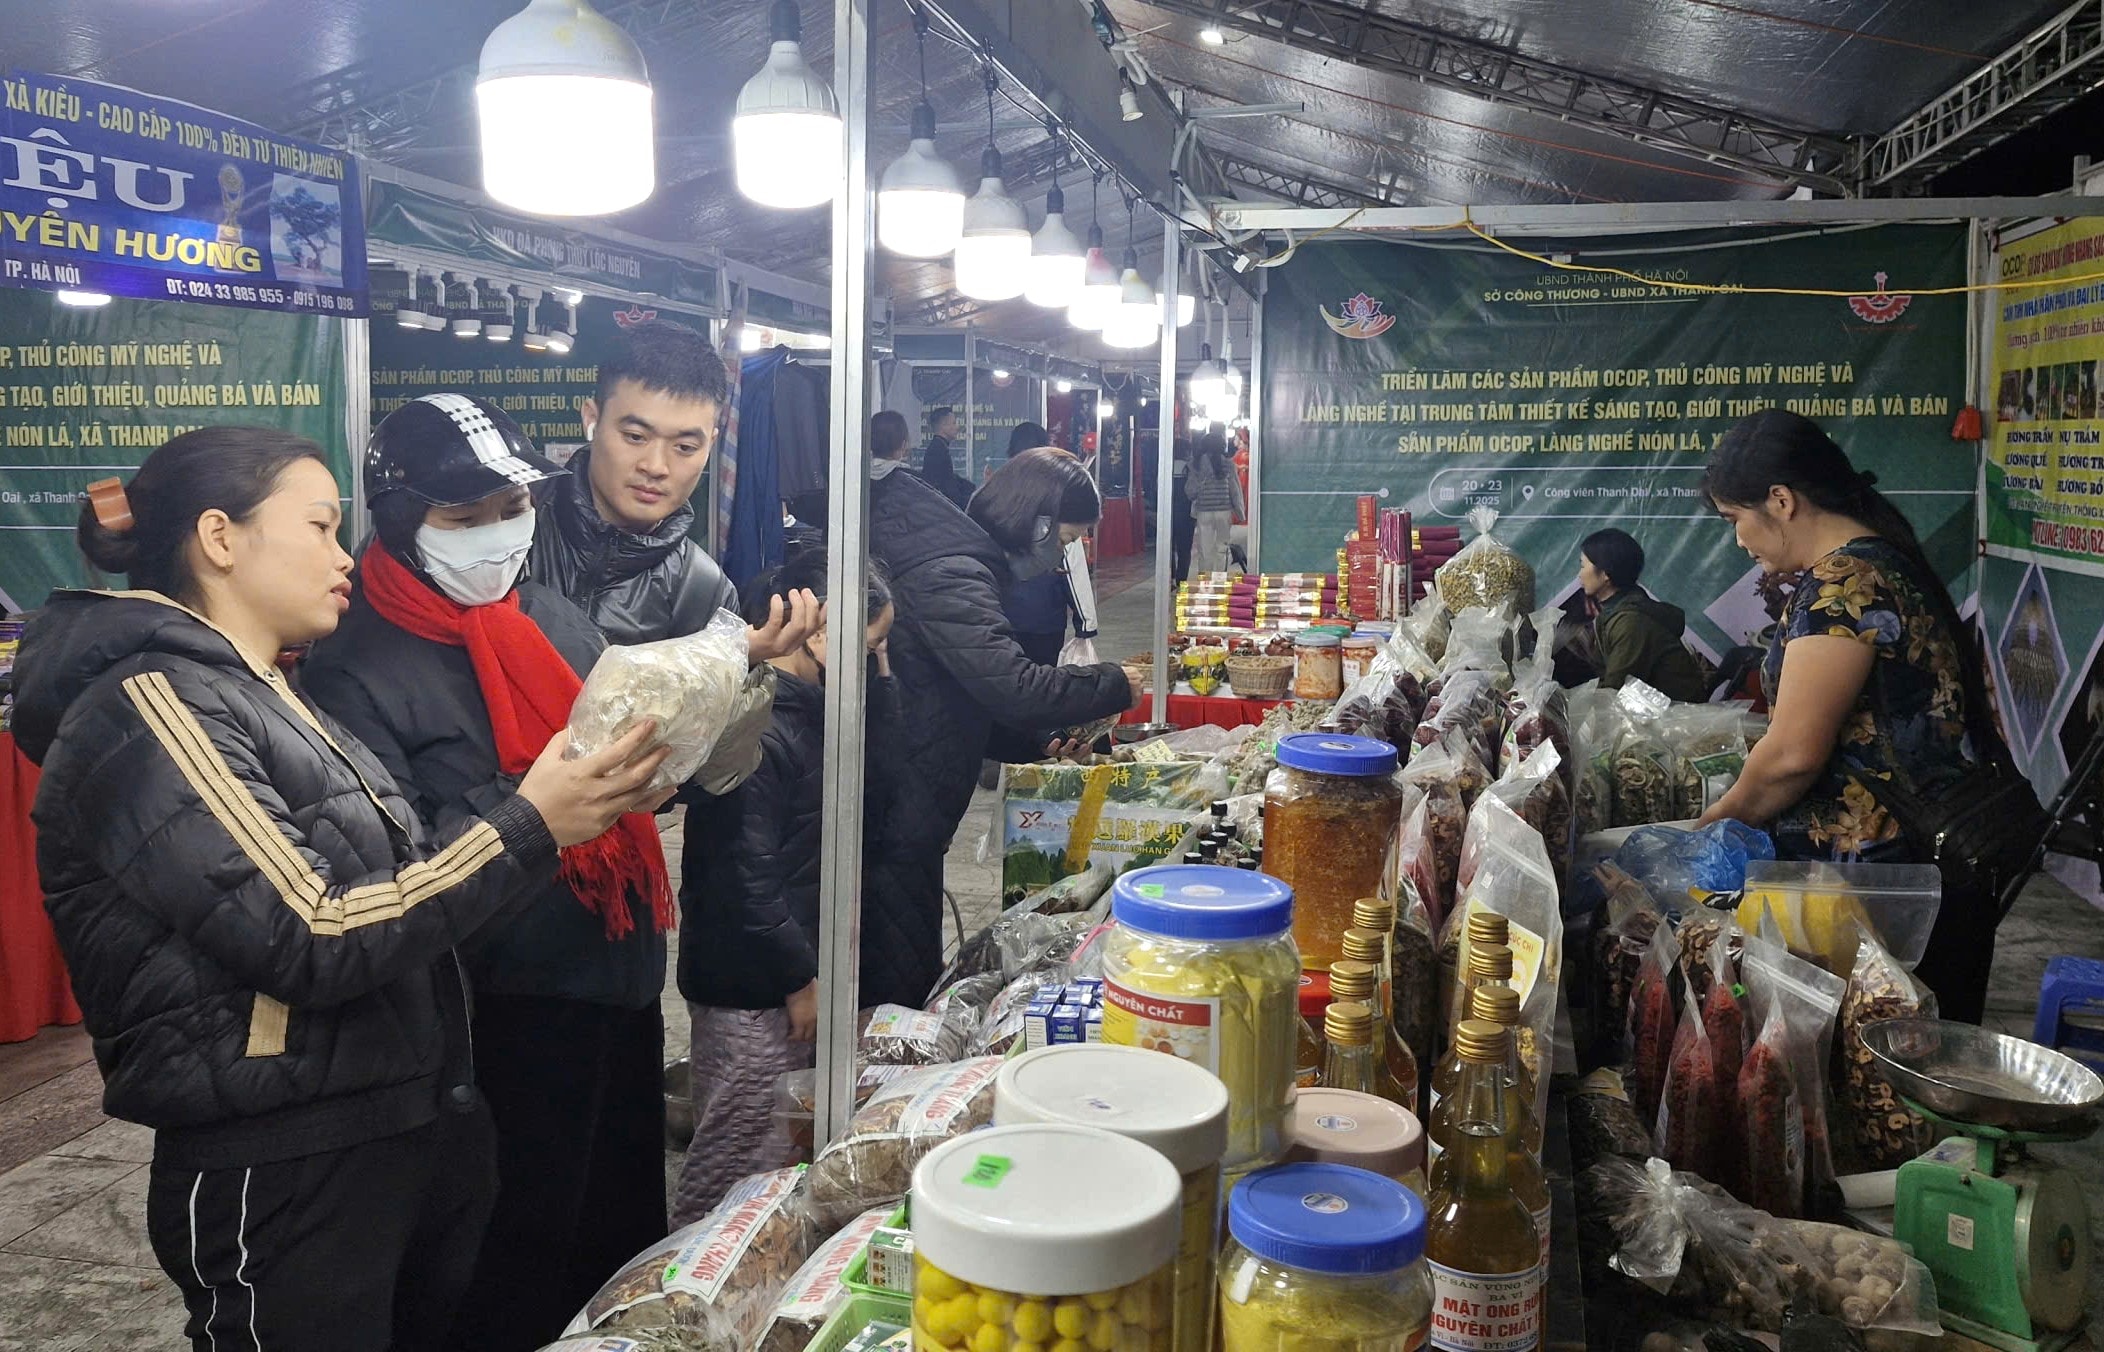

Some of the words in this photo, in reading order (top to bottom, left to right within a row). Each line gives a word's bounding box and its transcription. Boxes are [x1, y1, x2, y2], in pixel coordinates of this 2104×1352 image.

[35, 83, 81, 121] KIỀU
[99, 101, 134, 133] CAO
[138, 106, 171, 140] CẤP
[175, 119, 218, 154] 100%
[272, 142, 307, 172] THIÊN
[309, 151, 344, 180] NHIÊN
[115, 228, 262, 272] HƯƠNG
[31, 260, 52, 283] HÀ
[54, 265, 82, 287] NỘI
[189, 282, 212, 298] 024
[215, 285, 231, 300] 33
[233, 287, 257, 302] 985
[259, 288, 284, 304] 955
[315, 293, 334, 309] 196
[1536, 274, 1568, 286] UBND
[1572, 270, 1611, 285] THÀNH
[1645, 270, 1661, 281] HÀ
[1665, 268, 1689, 282] NỘI
[1484, 288, 1501, 302] SỞ
[1505, 288, 1544, 302] CÔNG
[1547, 287, 1600, 301] THƯƠNG
[1611, 287, 1646, 299] UBND
[18, 339, 51, 367] THỦ
[56, 341, 105, 366] CÔNG
[110, 339, 138, 366] MỸ
[144, 340, 193, 369] NGHỆ
[198, 339, 222, 365] VÀ
[372, 366, 398, 385] SẢN
[401, 364, 437, 385] PHẨM
[440, 369, 474, 385] OCOP,
[478, 365, 501, 384] THỦ
[506, 366, 540, 383] CÔNG
[543, 364, 564, 383] MỸ
[1381, 366, 1428, 391] TRIỂN
[1432, 369, 1467, 390] LÃM
[1472, 368, 1504, 390] CÁC
[1509, 366, 1544, 389] SẢN
[1549, 363, 1598, 388] PHẨM
[1603, 368, 1649, 388] OCOP,
[1655, 362, 1687, 386] THỦ
[1692, 363, 1741, 386] CÔNG
[1745, 362, 1773, 384] MỸ
[1777, 361, 1826, 387] NGHỆ
[1830, 361, 1854, 384] VÀ
[52, 381, 88, 406] GIỚI
[92, 381, 150, 410] THIỆU,
[154, 378, 217, 407] QUẢNG
[222, 380, 247, 406] BÁ
[251, 381, 277, 406] VÀ
[281, 380, 321, 406] BÁN
[503, 394, 527, 411] GIỚI
[530, 394, 569, 413] THIỆU,
[1300, 401, 1340, 422] LÀNG
[1343, 399, 1387, 422] NGHỀ
[1391, 402, 1416, 425] TẠI
[1421, 402, 1474, 422] TRUNG
[1478, 400, 1514, 421] TÂM
[1518, 397, 1565, 421] THIẾT
[1568, 397, 1591, 420] KẾ
[1594, 396, 1640, 419] SÁNG
[1645, 400, 1681, 424] TẠO,
[1686, 397, 1722, 418] GIỚI
[1786, 393, 1846, 417] QUẢNG
[1851, 393, 1877, 417] BÁ
[1881, 393, 1906, 416] VÀ
[1910, 392, 1948, 416] BÁN
[6, 423, 43, 447] NÓN
[49, 422, 75, 449] LÁ,
[79, 421, 104, 446] XÃ
[108, 425, 169, 447] THANH
[540, 423, 583, 437] THANH
[1398, 431, 1432, 454] SẢN
[1436, 429, 1484, 453] PHẨM
[1489, 433, 1535, 455] OCOP,
[1540, 432, 1583, 453] LÀNG
[1588, 430, 1634, 453] NGHỀ
[1638, 431, 1676, 452] NÓN
[1680, 431, 1706, 453] LÁ,
[1462, 480, 1478, 491] 20
[1488, 479, 1503, 491] 23
[1544, 486, 1571, 500] Công
[1573, 486, 1595, 498] viên
[1597, 487, 1628, 498] Thanh
[1672, 486, 1701, 498] Than
[1464, 495, 1500, 506] 11.2025
[1108, 991, 1145, 1013] NGUYÊN
[1147, 1004, 1184, 1020] CHẤT
[1483, 1281, 1521, 1291] VÙNG
[1489, 1293, 1507, 1302] BA
[1443, 1296, 1481, 1318] MẬT
[1486, 1303, 1520, 1319] ONG
[1497, 1314, 1533, 1338] CHẤT
